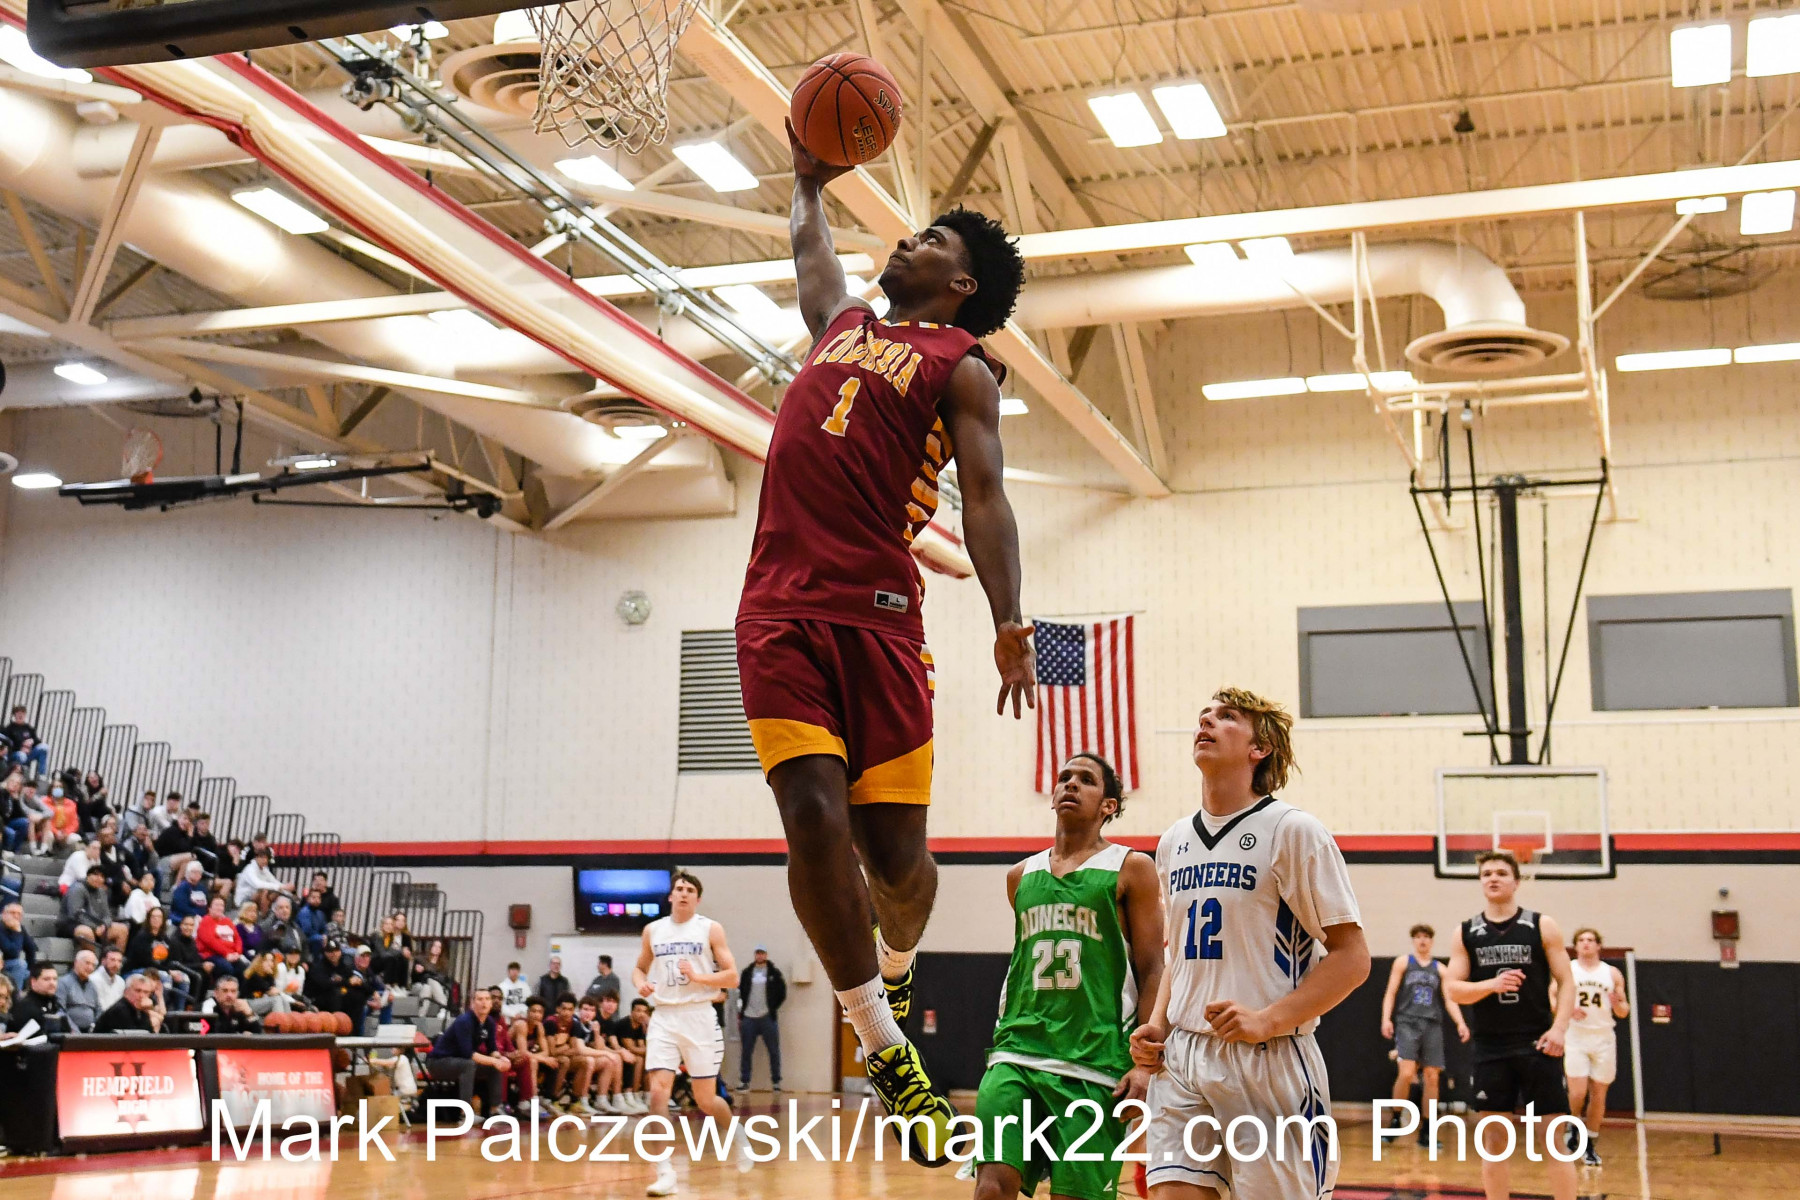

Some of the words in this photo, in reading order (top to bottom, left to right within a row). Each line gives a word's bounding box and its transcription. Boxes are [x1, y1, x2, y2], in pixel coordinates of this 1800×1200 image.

[821, 377, 861, 437] 1
[1169, 862, 1257, 895] PIONEERS
[1021, 902, 1103, 942] DONEGAL
[1185, 898, 1223, 960] 12
[1032, 939, 1082, 991] 23
[1578, 991, 1602, 1008] 24
[82, 1075, 174, 1097] HEMPFIELD
[288, 1071, 303, 1085] OF
[303, 1071, 324, 1085] THE
